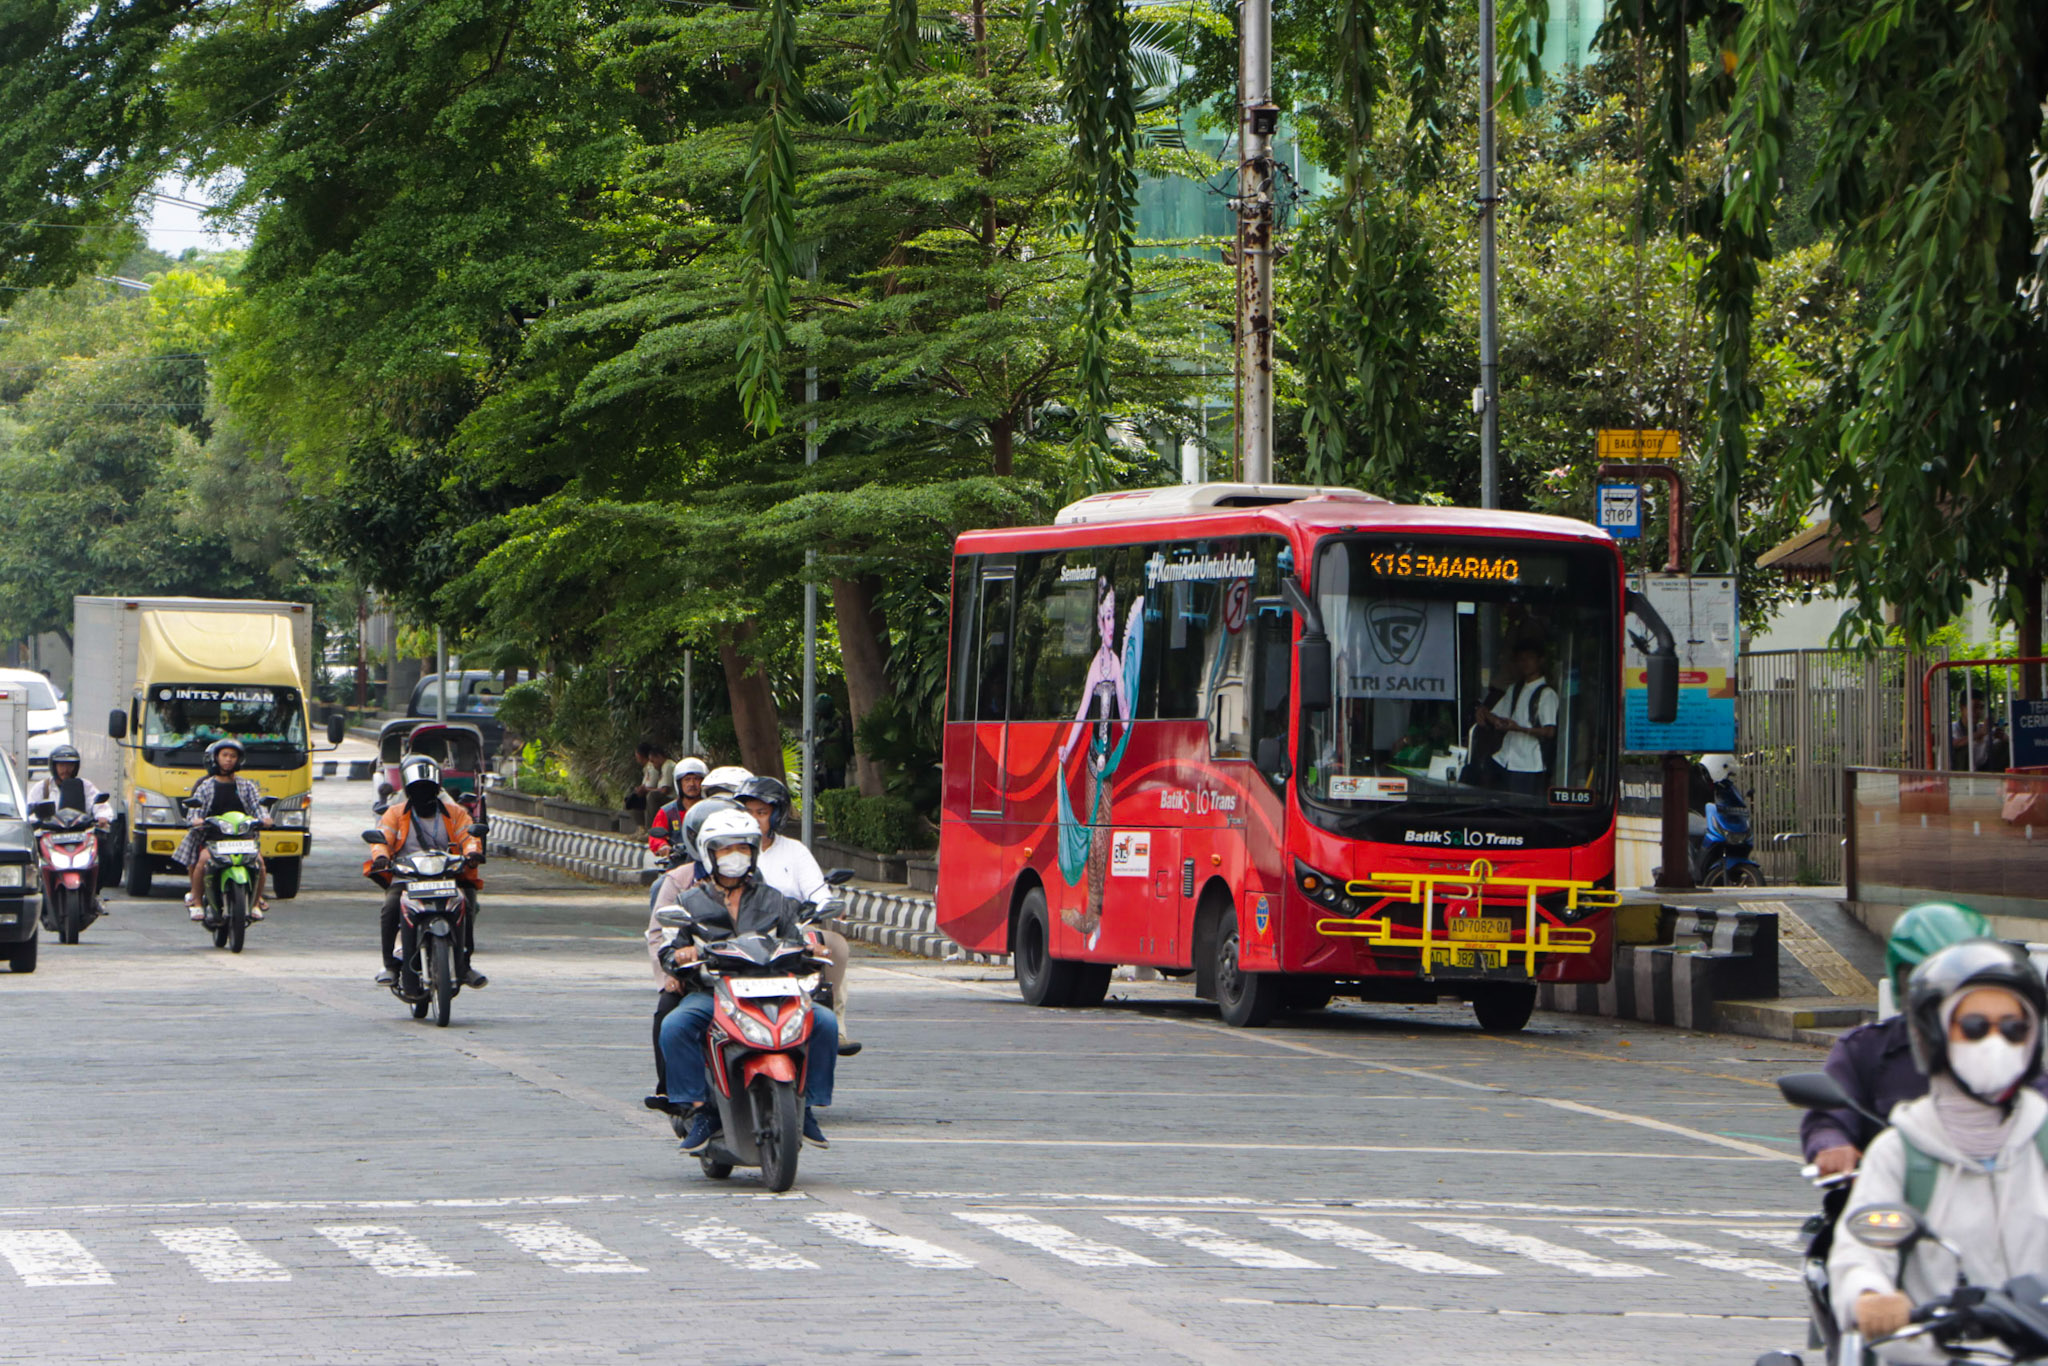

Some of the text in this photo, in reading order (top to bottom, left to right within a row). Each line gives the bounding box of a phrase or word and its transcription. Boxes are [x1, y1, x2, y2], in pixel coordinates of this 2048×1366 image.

[1614, 438, 1663, 449] BALAKOTA
[1604, 509, 1633, 522] STOP
[1060, 563, 1097, 582] Sembadra
[1148, 551, 1255, 589] #KamiAdaUntukAnda
[1350, 675, 1445, 692] TRI SAKTI
[176, 689, 274, 702] INTER MILAN
[1161, 789, 1184, 809] Batik
[1211, 791, 1236, 811] Trans
[1554, 791, 1569, 801] TB
[1404, 830, 1442, 843] Batik
[1485, 833, 1524, 846] Trans
[1452, 919, 1465, 932] AD
